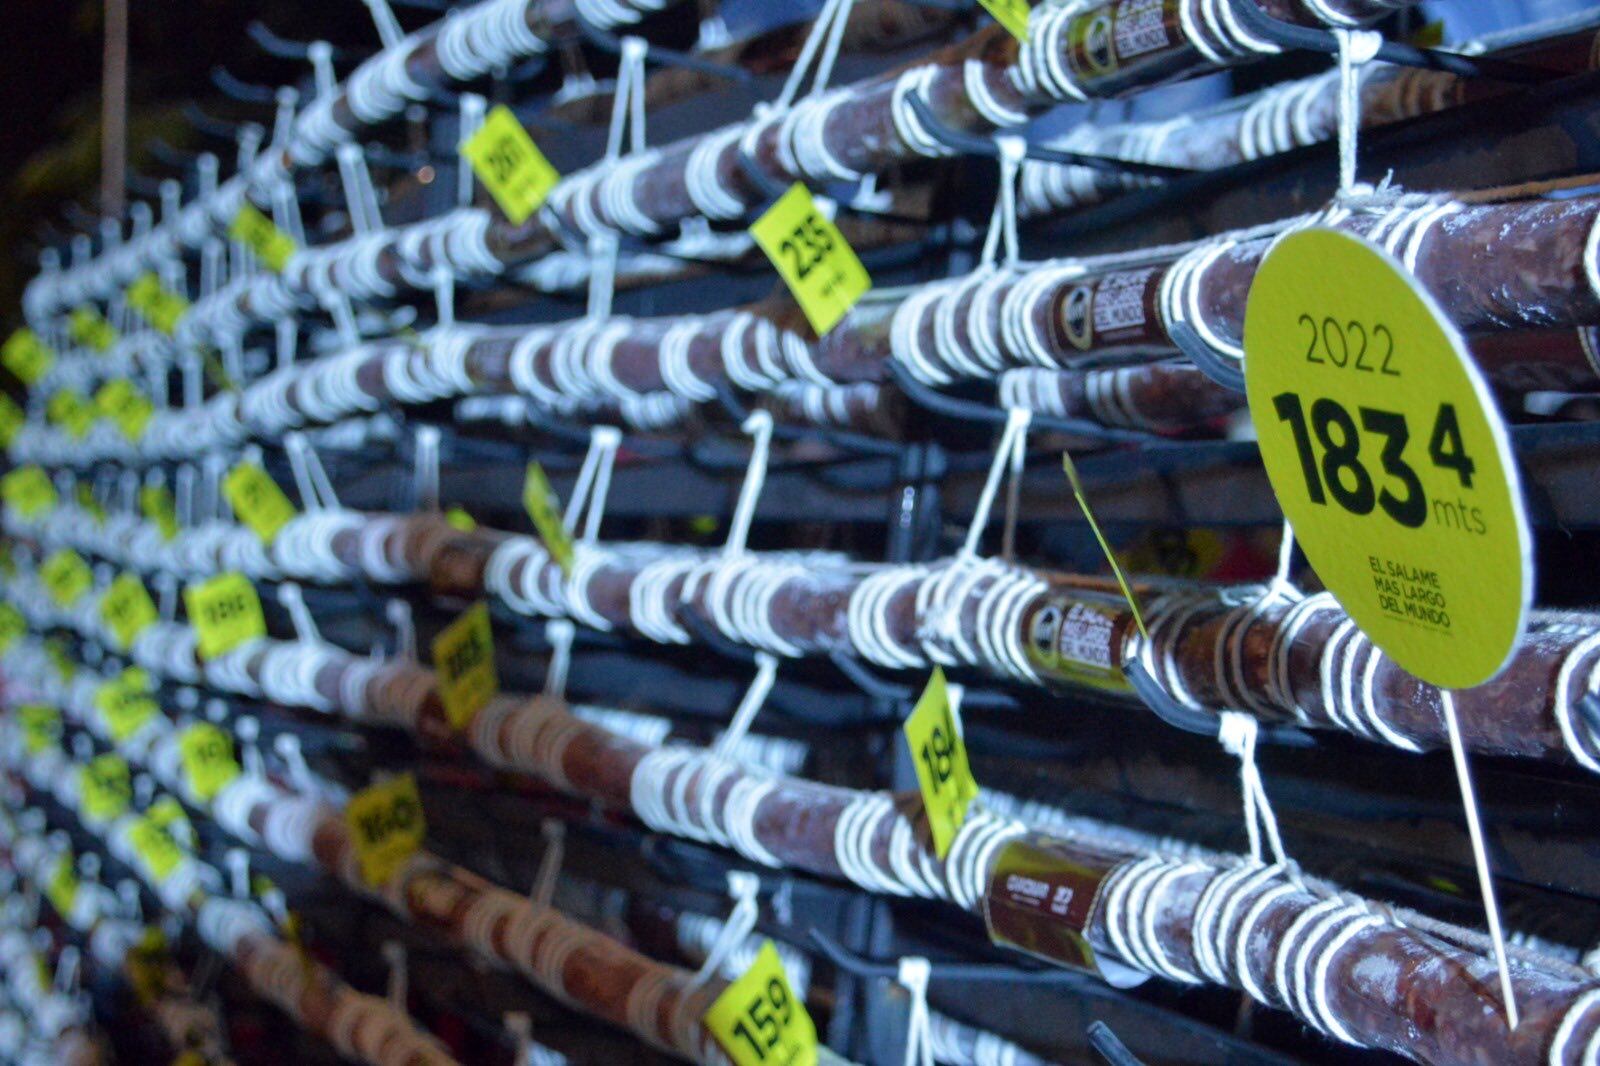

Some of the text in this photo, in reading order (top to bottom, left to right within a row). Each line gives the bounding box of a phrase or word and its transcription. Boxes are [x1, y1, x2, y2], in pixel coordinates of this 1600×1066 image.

[780, 214, 834, 280] 235
[1298, 313, 1401, 376] 2022
[1432, 498, 1487, 536] mts
[1368, 555, 1441, 590] EL SALAME
[1373, 575, 1446, 608] MAS LARGO
[1379, 593, 1404, 615] DEL
[1404, 601, 1451, 628] MUNDO
[733, 976, 793, 1061] 159
